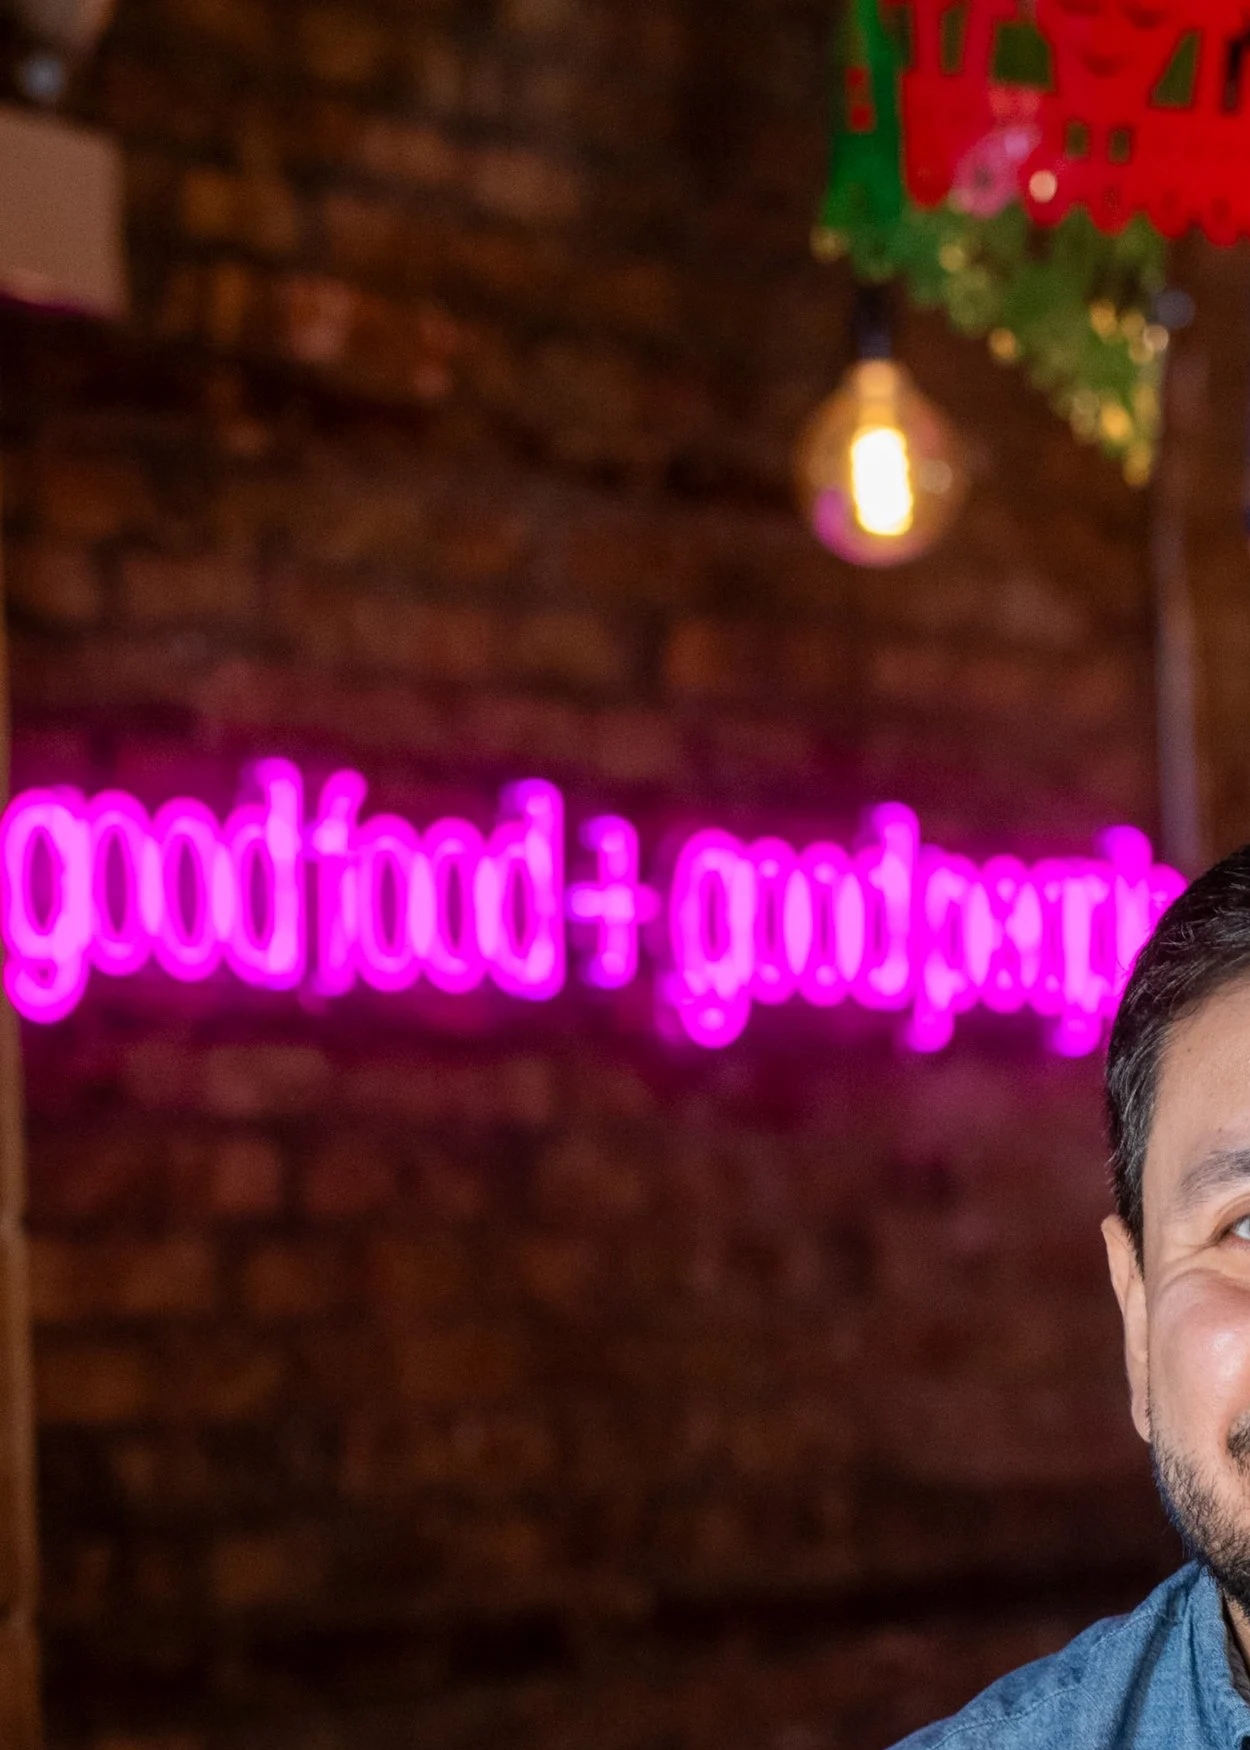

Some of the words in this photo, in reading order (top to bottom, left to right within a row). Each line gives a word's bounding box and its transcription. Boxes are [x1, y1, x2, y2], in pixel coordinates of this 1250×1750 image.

[1, 760, 302, 1022] good
[312, 771, 564, 1000] food
[672, 804, 920, 1048] good
